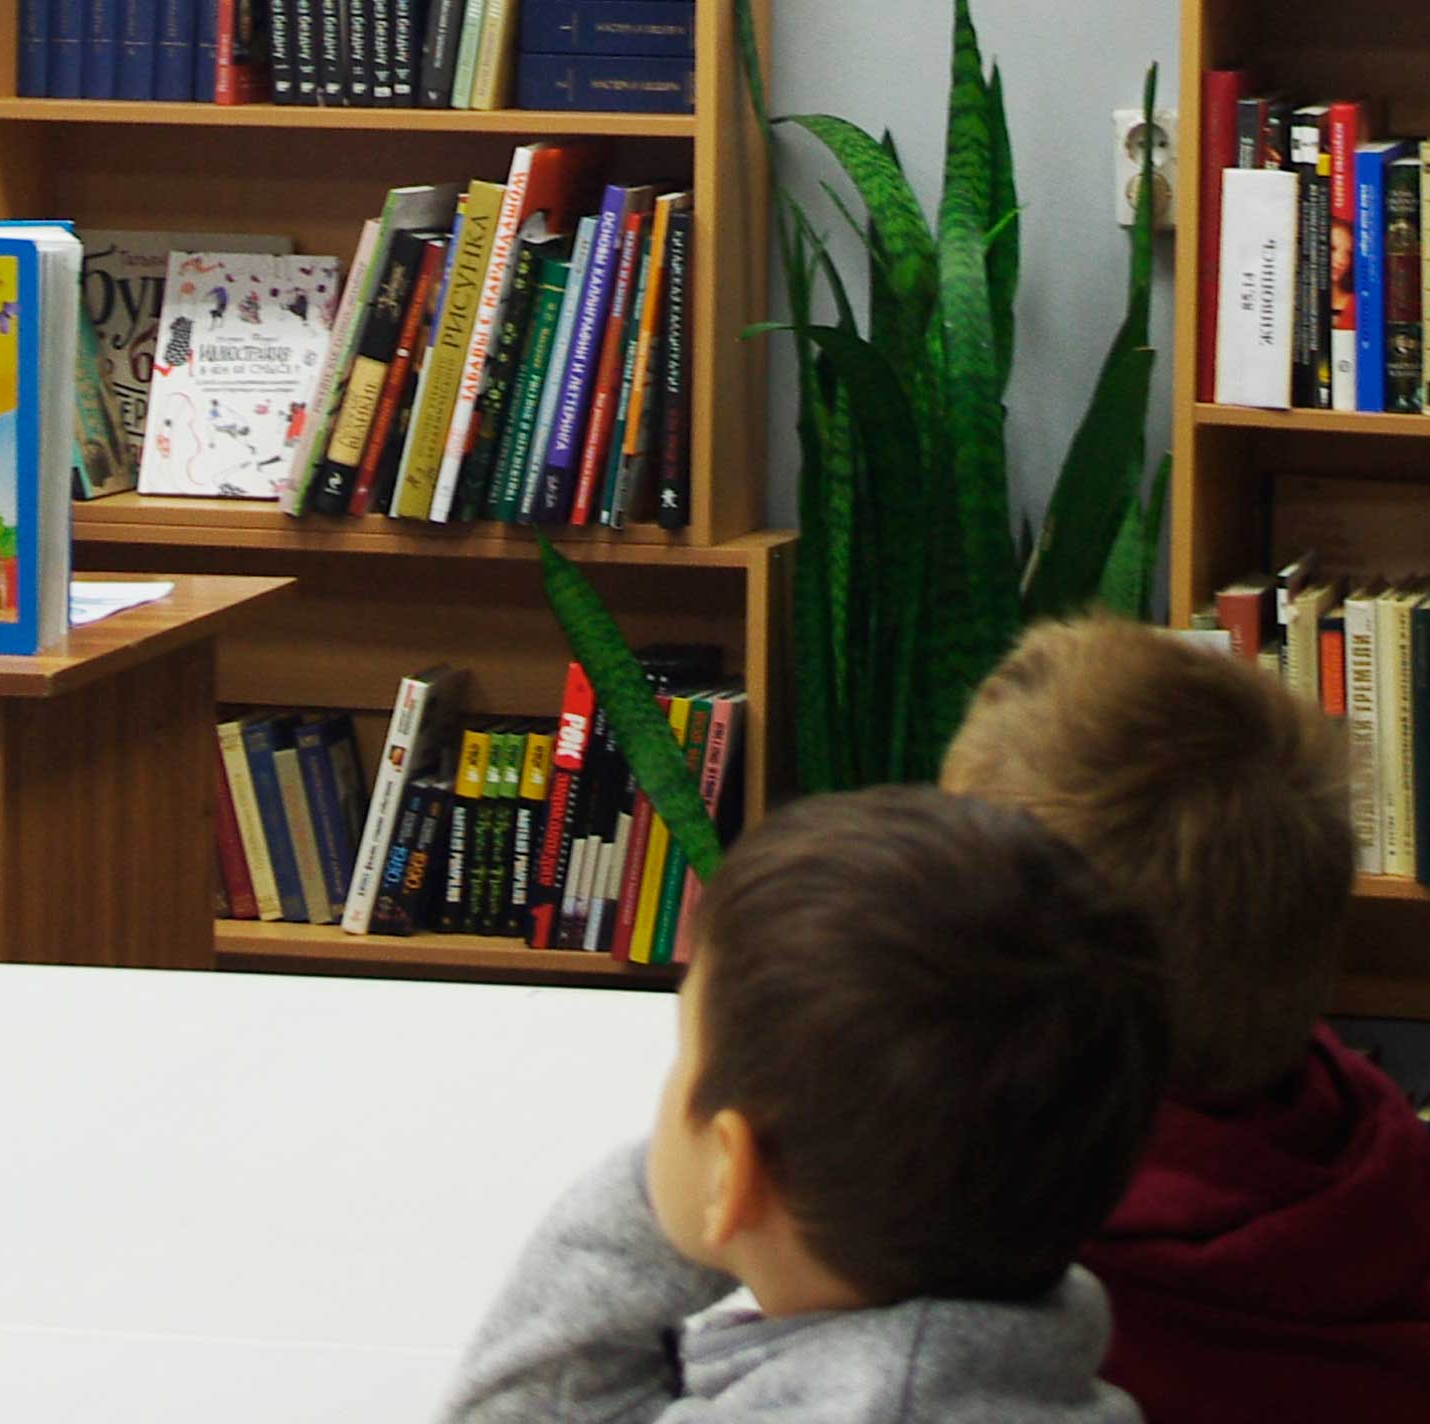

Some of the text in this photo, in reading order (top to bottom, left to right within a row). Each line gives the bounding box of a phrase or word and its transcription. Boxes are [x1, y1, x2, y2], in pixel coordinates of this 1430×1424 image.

[272, 15, 287, 58] бездну
[297, 15, 313, 59] бездну
[322, 17, 338, 60] бездну
[351, 17, 366, 61] бездну
[374, 21, 389, 64] бездну
[396, 18, 409, 62] бездну
[480, 169, 528, 310] КАРАНДАШОМ
[591, 210, 616, 266] ОСНОВЫ
[440, 211, 492, 350] РИСУНКА
[1259, 238, 1276, 345] ЖИВОПИСЬ
[572, 266, 605, 362] КАЛЛИГРАФИИ
[552, 710, 589, 760] РОК
